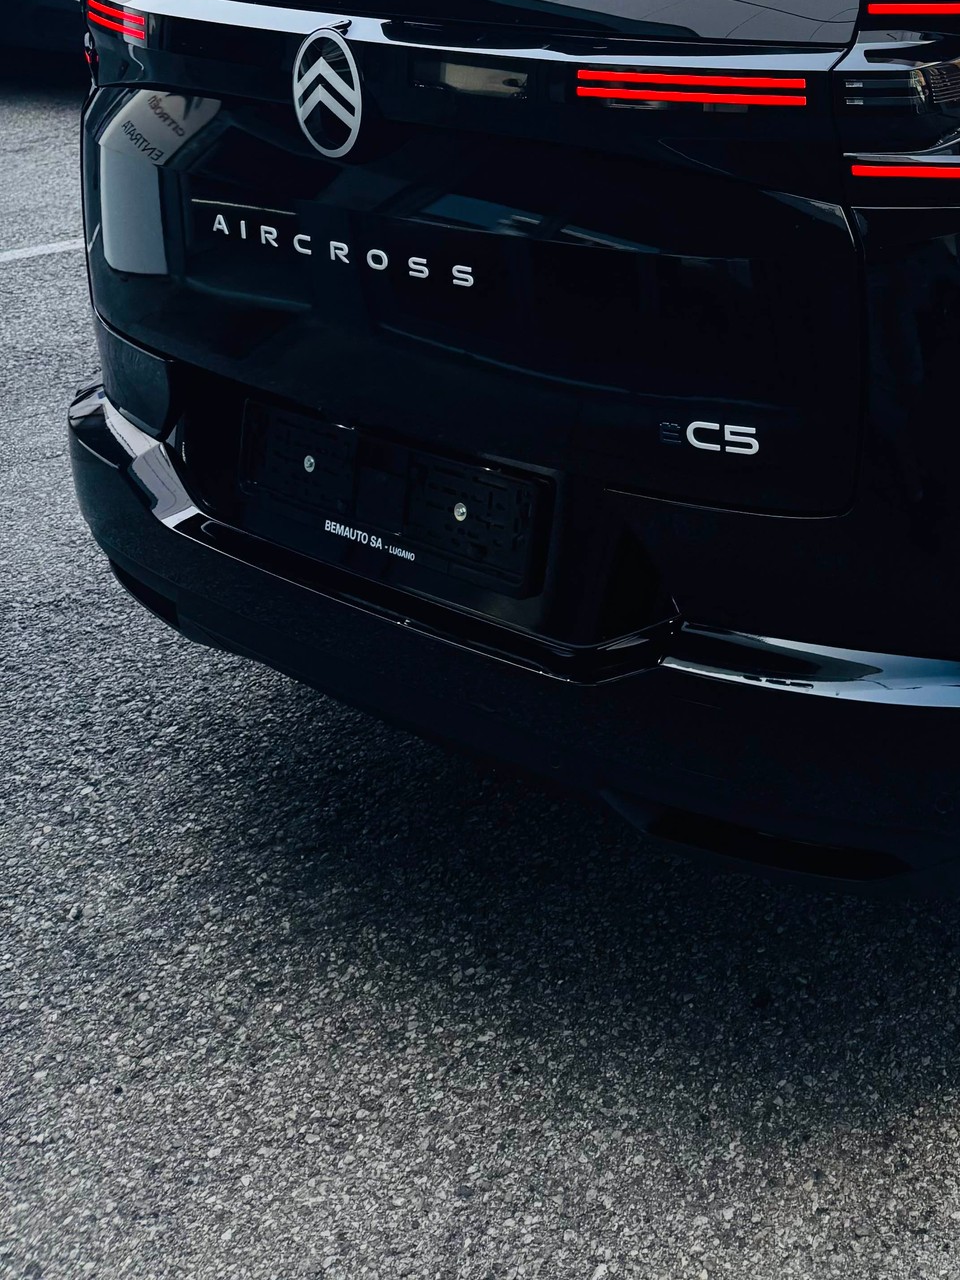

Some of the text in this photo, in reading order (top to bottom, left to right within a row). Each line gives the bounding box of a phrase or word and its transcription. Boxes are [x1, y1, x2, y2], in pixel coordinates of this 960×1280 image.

[213, 214, 475, 287] AIRCROSS
[324, 519, 369, 545] BEMAUTO
[370, 535, 383, 550] SA
[389, 545, 416, 562] LUGANO
